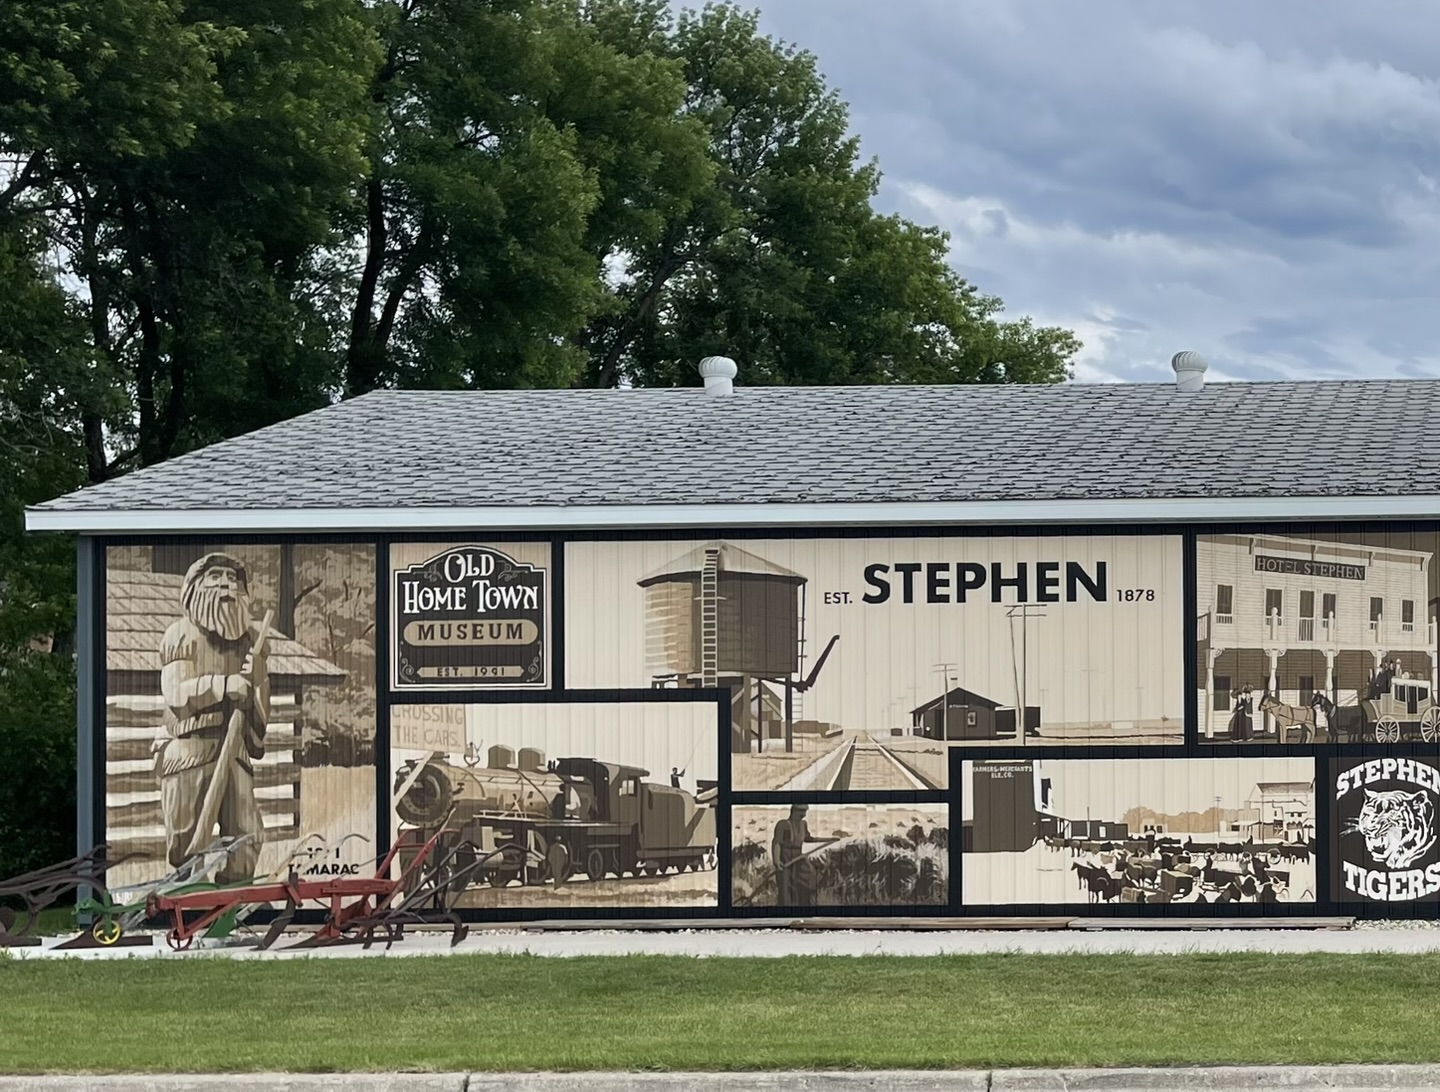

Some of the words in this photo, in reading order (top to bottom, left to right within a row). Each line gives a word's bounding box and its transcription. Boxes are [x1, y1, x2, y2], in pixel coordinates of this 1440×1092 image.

[444, 553, 495, 583] OLD
[1256, 557, 1301, 574] HOTEL
[1303, 562, 1364, 579] STEPHEN
[823, 591, 853, 604] EST.
[861, 560, 1107, 604] STEPHEN
[1116, 588, 1155, 602] 1878
[402, 581, 467, 614] HOME
[471, 579, 539, 613] TOWN
[417, 622, 524, 641] MUSEUM
[436, 667, 463, 677] EST.
[474, 666, 505, 677] 1991
[393, 725, 419, 744] THE
[288, 863, 360, 876] TMARAC
